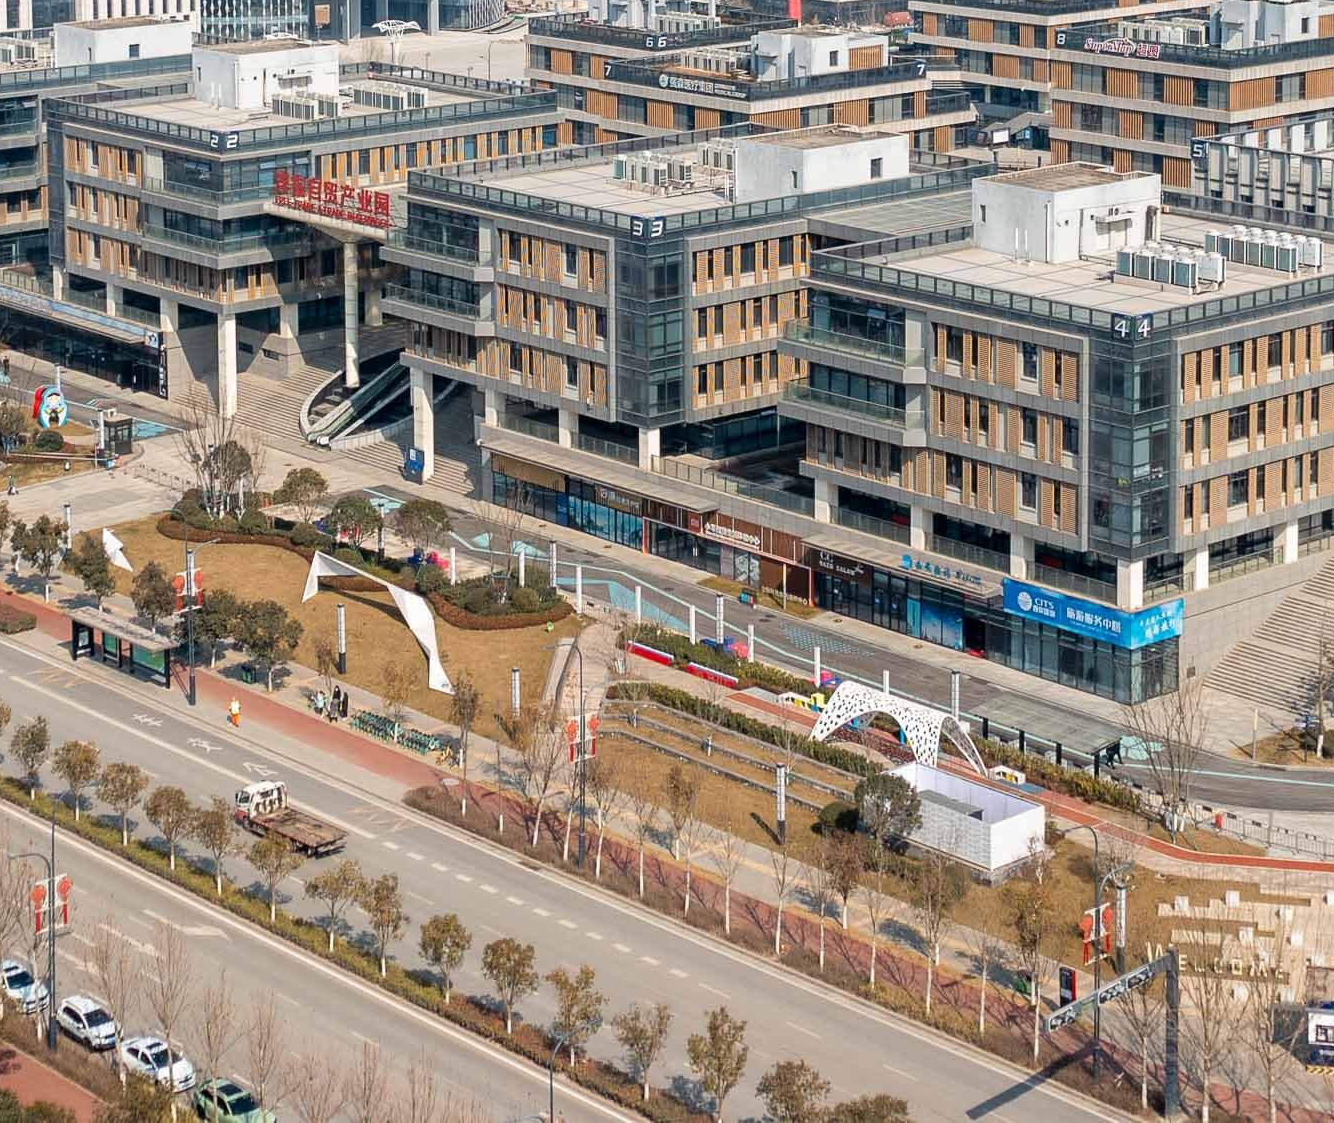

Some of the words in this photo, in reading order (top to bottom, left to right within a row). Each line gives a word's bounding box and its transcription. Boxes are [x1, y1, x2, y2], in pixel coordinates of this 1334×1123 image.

[645, 37, 653, 48] 6
[657, 36, 667, 48] 6
[1057, 34, 1066, 45] 8
[604, 65, 612, 76] 7
[917, 64, 925, 76] 7
[210, 134, 219, 148] 2
[227, 134, 238, 149] 2
[633, 220, 643, 236] 3
[651, 220, 663, 237] 3
[1114, 319, 1129, 337] 4
[1137, 319, 1151, 337] 4
